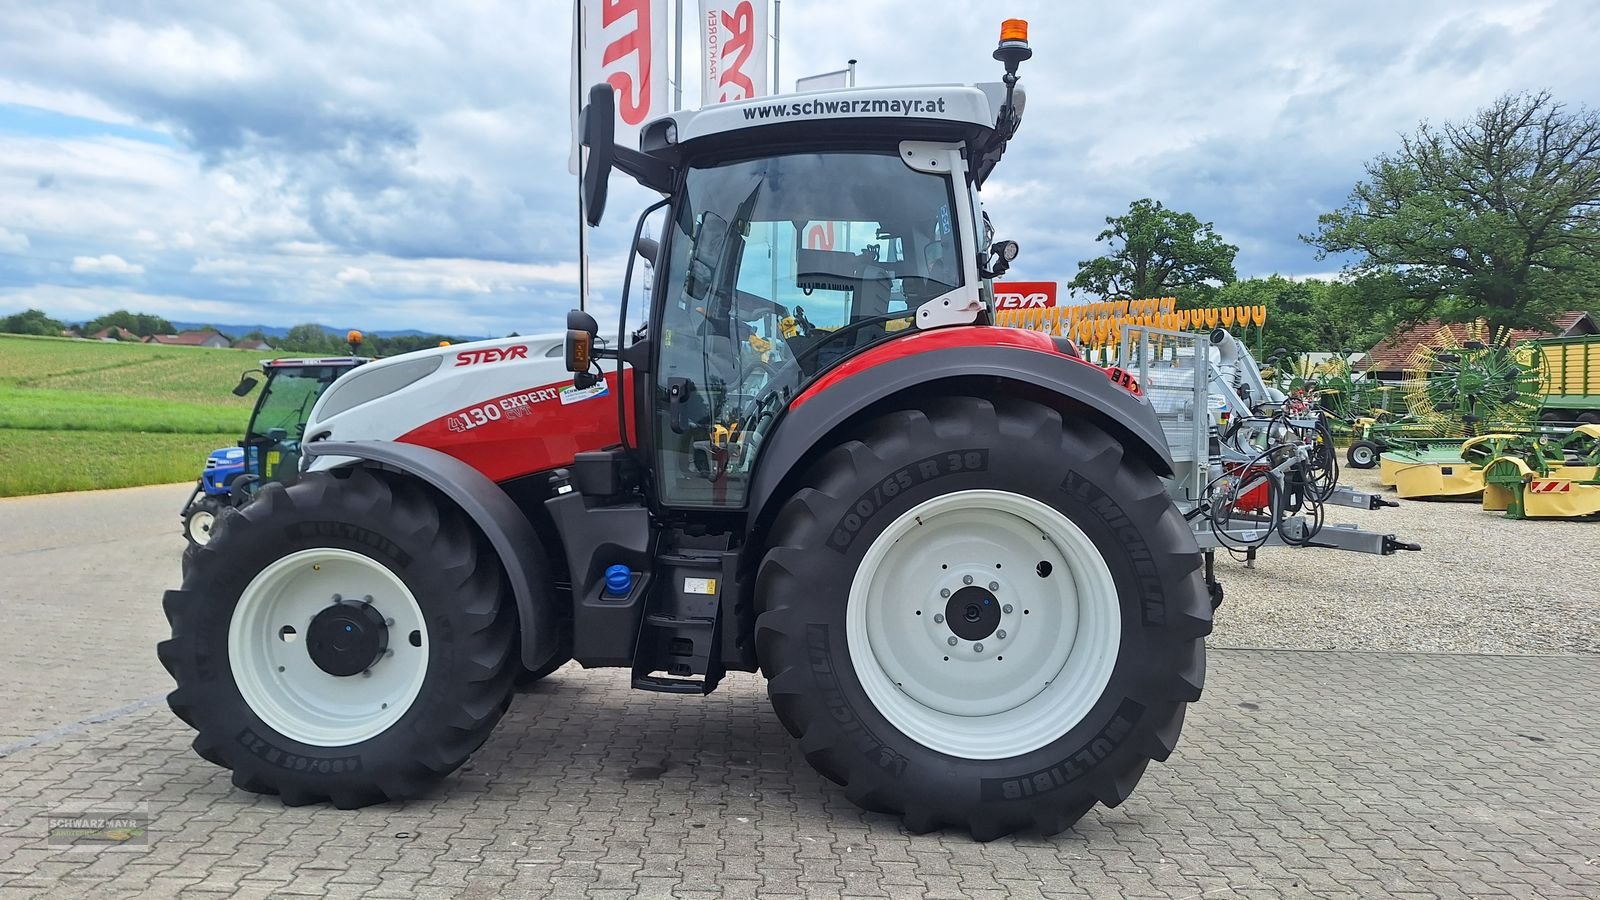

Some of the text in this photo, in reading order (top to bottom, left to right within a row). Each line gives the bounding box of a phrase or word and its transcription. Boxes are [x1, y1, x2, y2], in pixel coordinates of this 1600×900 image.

[743, 97, 945, 120] www.schwarzmayr.at
[994, 293, 1048, 308] TEYR
[454, 345, 528, 367] STEYR
[448, 404, 501, 432] 4130
[500, 388, 558, 411] EXPERT
[505, 405, 533, 420] CVT
[833, 452, 982, 546] 600/65 R 38
[1002, 714, 1131, 799] MULTIBIB
